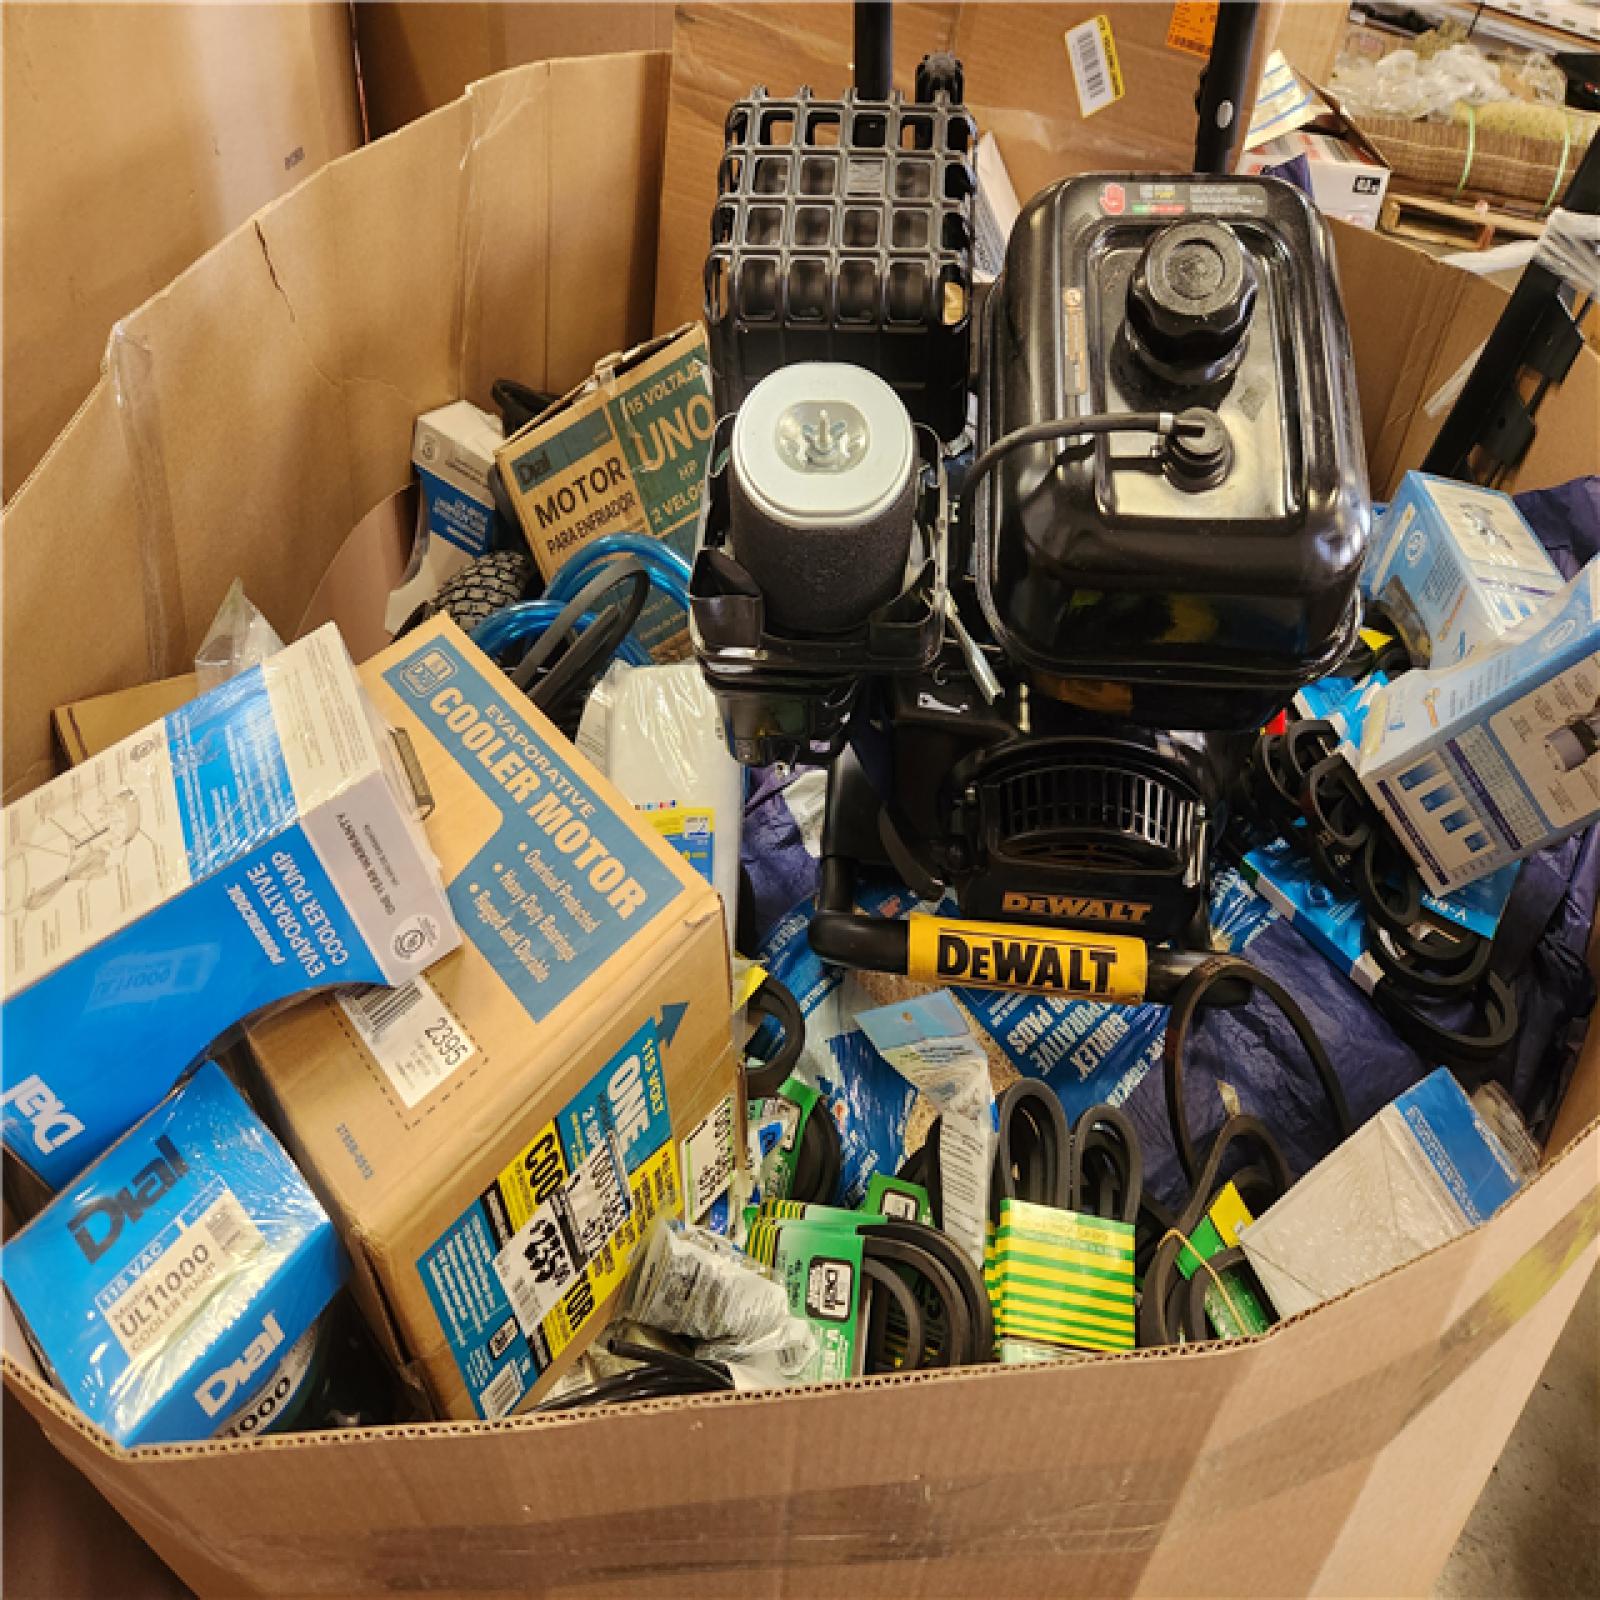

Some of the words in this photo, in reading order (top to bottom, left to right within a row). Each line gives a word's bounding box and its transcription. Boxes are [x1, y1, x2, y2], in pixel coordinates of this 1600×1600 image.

[635, 394, 716, 473] UNO
[534, 456, 627, 529] MOTOR
[546, 528, 580, 555] PARA
[577, 489, 637, 542] ENFRIADOR
[485, 703, 597, 818] EVAPORATIVE
[429, 687, 541, 803] COOLER
[528, 791, 648, 921] MOTOR
[271, 851, 313, 903] PUMP
[1002, 891, 1153, 921] DEWALT
[247, 863, 326, 978] EVAPORATIVE
[299, 899, 348, 967] COOLER
[937, 934, 1119, 994] DEWALT
[424, 1017, 468, 1066] 2395
[642, 1038, 656, 1072] 115
[1006, 1003, 1055, 1055] PADS
[1069, 1011, 1131, 1083] CURLEX
[0, 1073, 86, 1156] Dial
[608, 1055, 651, 1154] ONE
[648, 1069, 665, 1115] VOLT
[67, 1134, 190, 1264] Dial
[525, 1132, 564, 1206] COO
[564, 1269, 596, 1332] TOR
[118, 1242, 211, 1340] UL11000
[129, 1241, 164, 1279] VAC
[130, 1302, 181, 1353] COOLER
[193, 1310, 286, 1417] Dial
